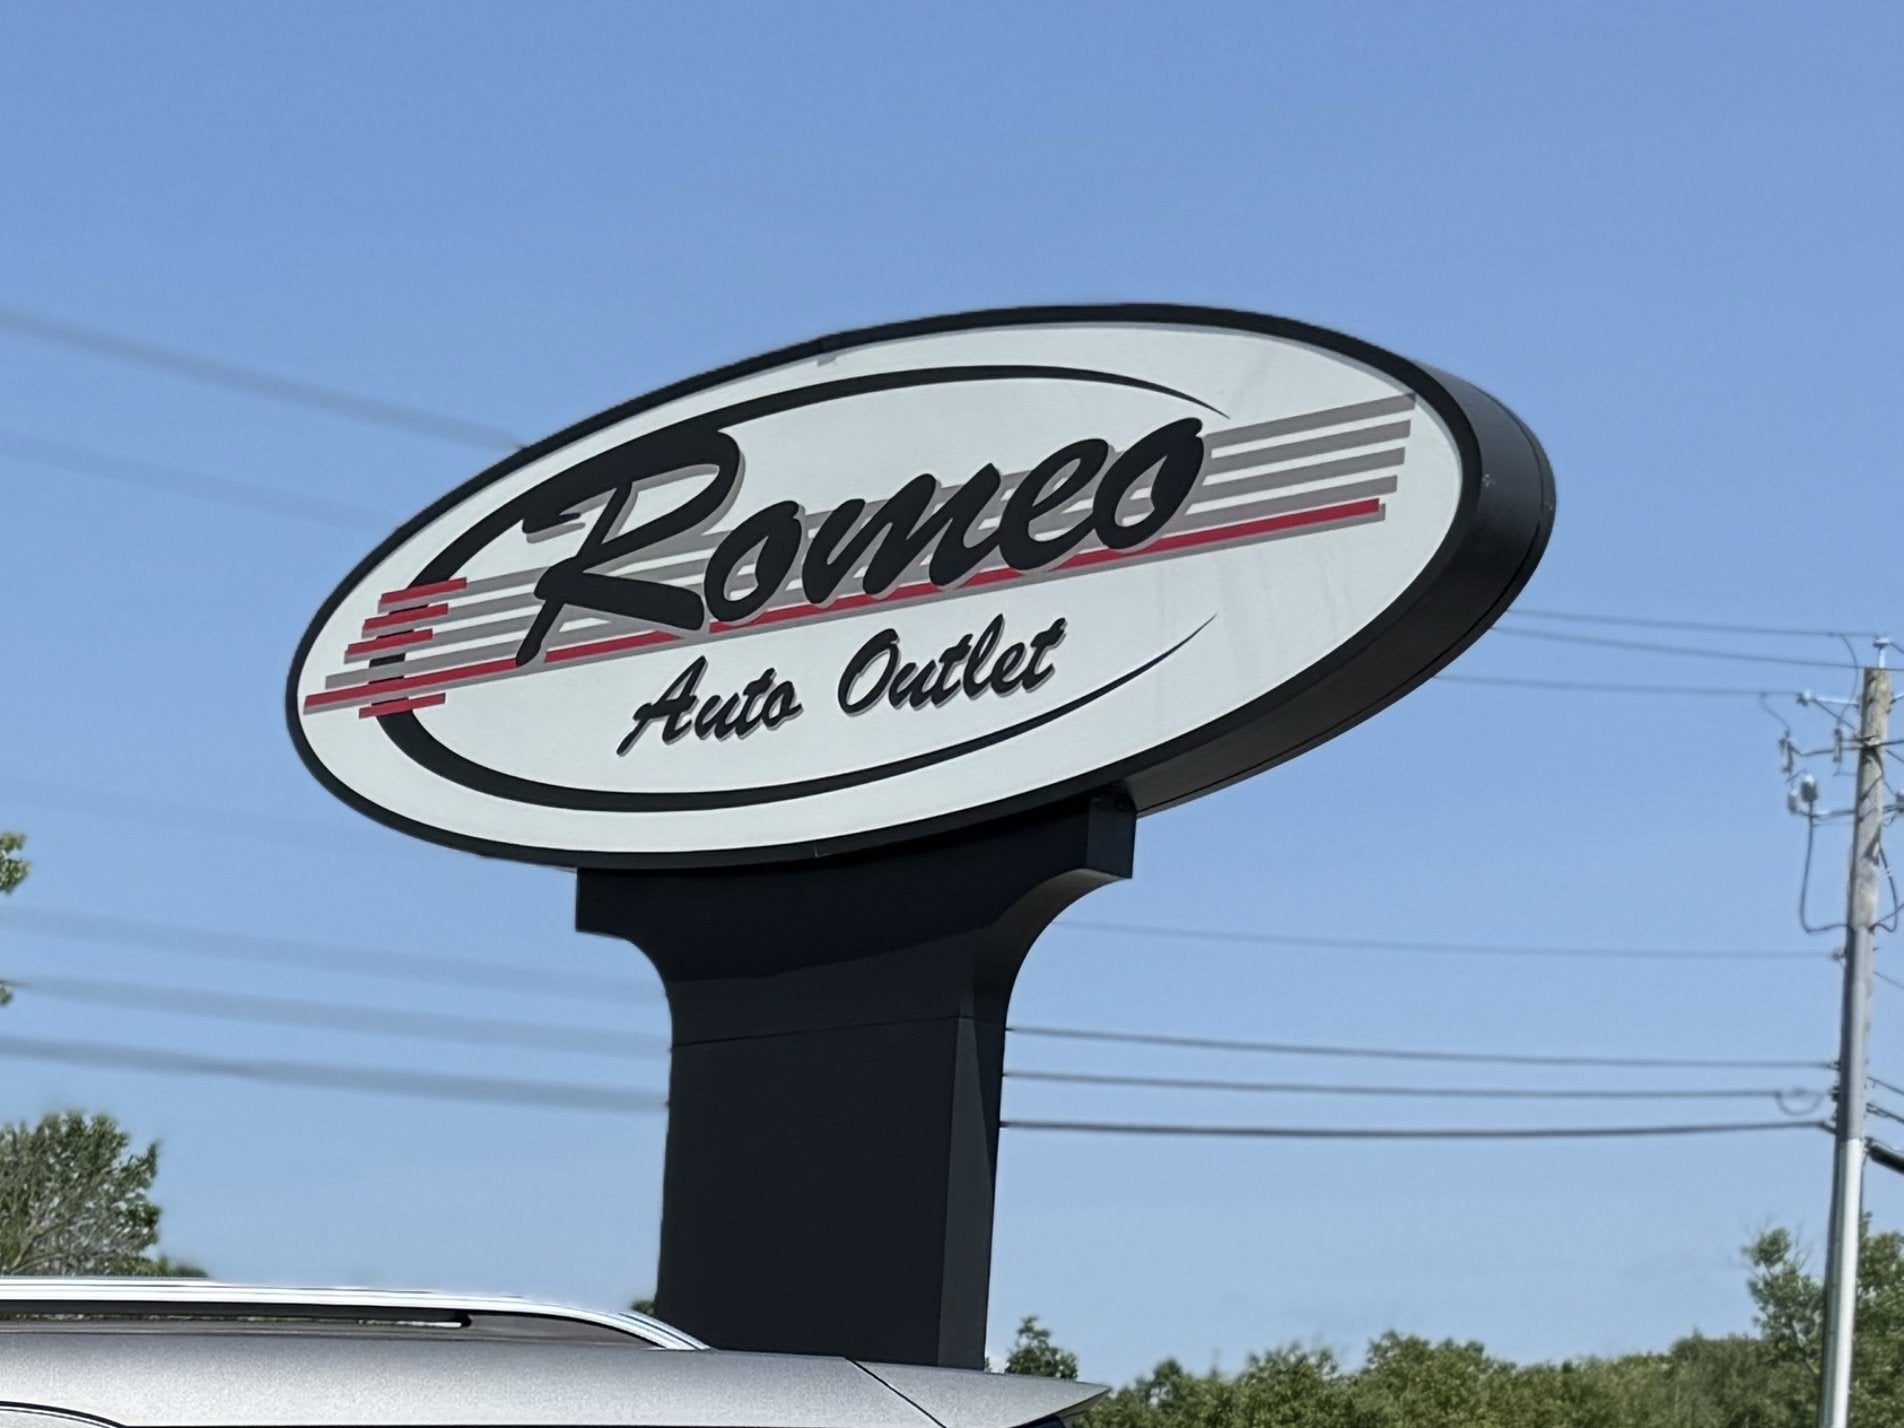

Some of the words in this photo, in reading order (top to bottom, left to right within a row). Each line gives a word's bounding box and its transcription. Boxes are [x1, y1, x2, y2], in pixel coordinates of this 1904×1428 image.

[517, 416, 1204, 668] Romeo
[616, 655, 801, 757] Auto
[837, 614, 1069, 716] Outlet
